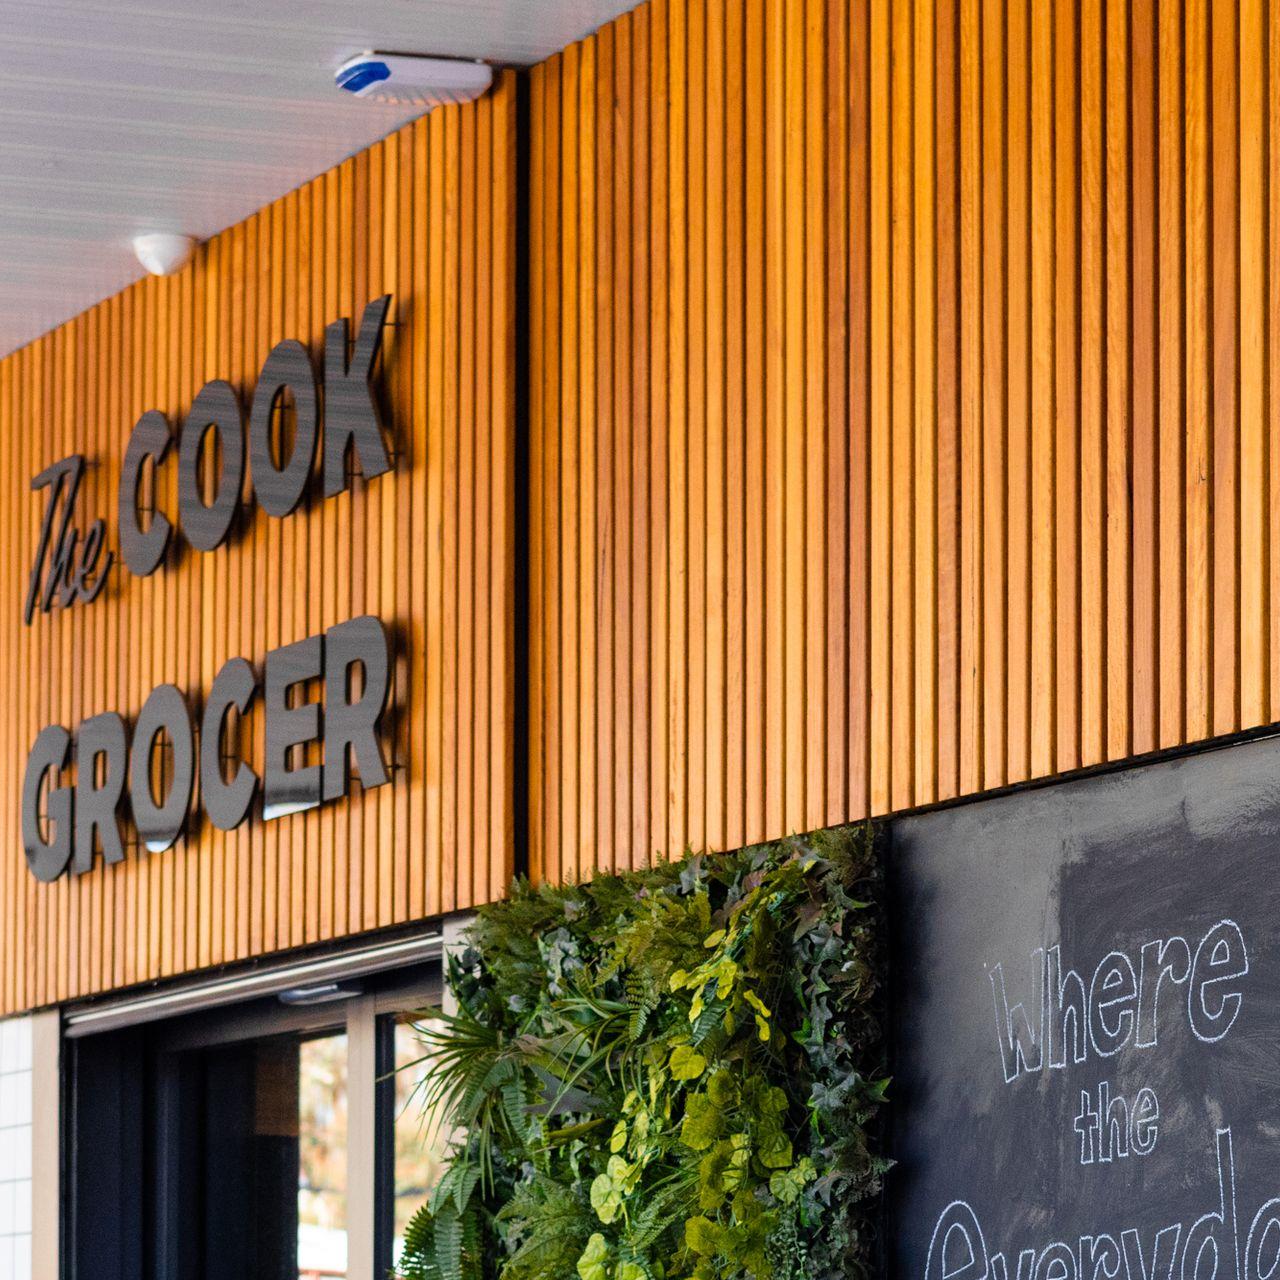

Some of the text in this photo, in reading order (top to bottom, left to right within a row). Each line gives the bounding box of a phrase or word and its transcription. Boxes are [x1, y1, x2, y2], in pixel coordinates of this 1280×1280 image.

[25, 293, 395, 627] The COOK
[21, 614, 392, 883] GROCER
[1074, 1081, 1160, 1165] the
